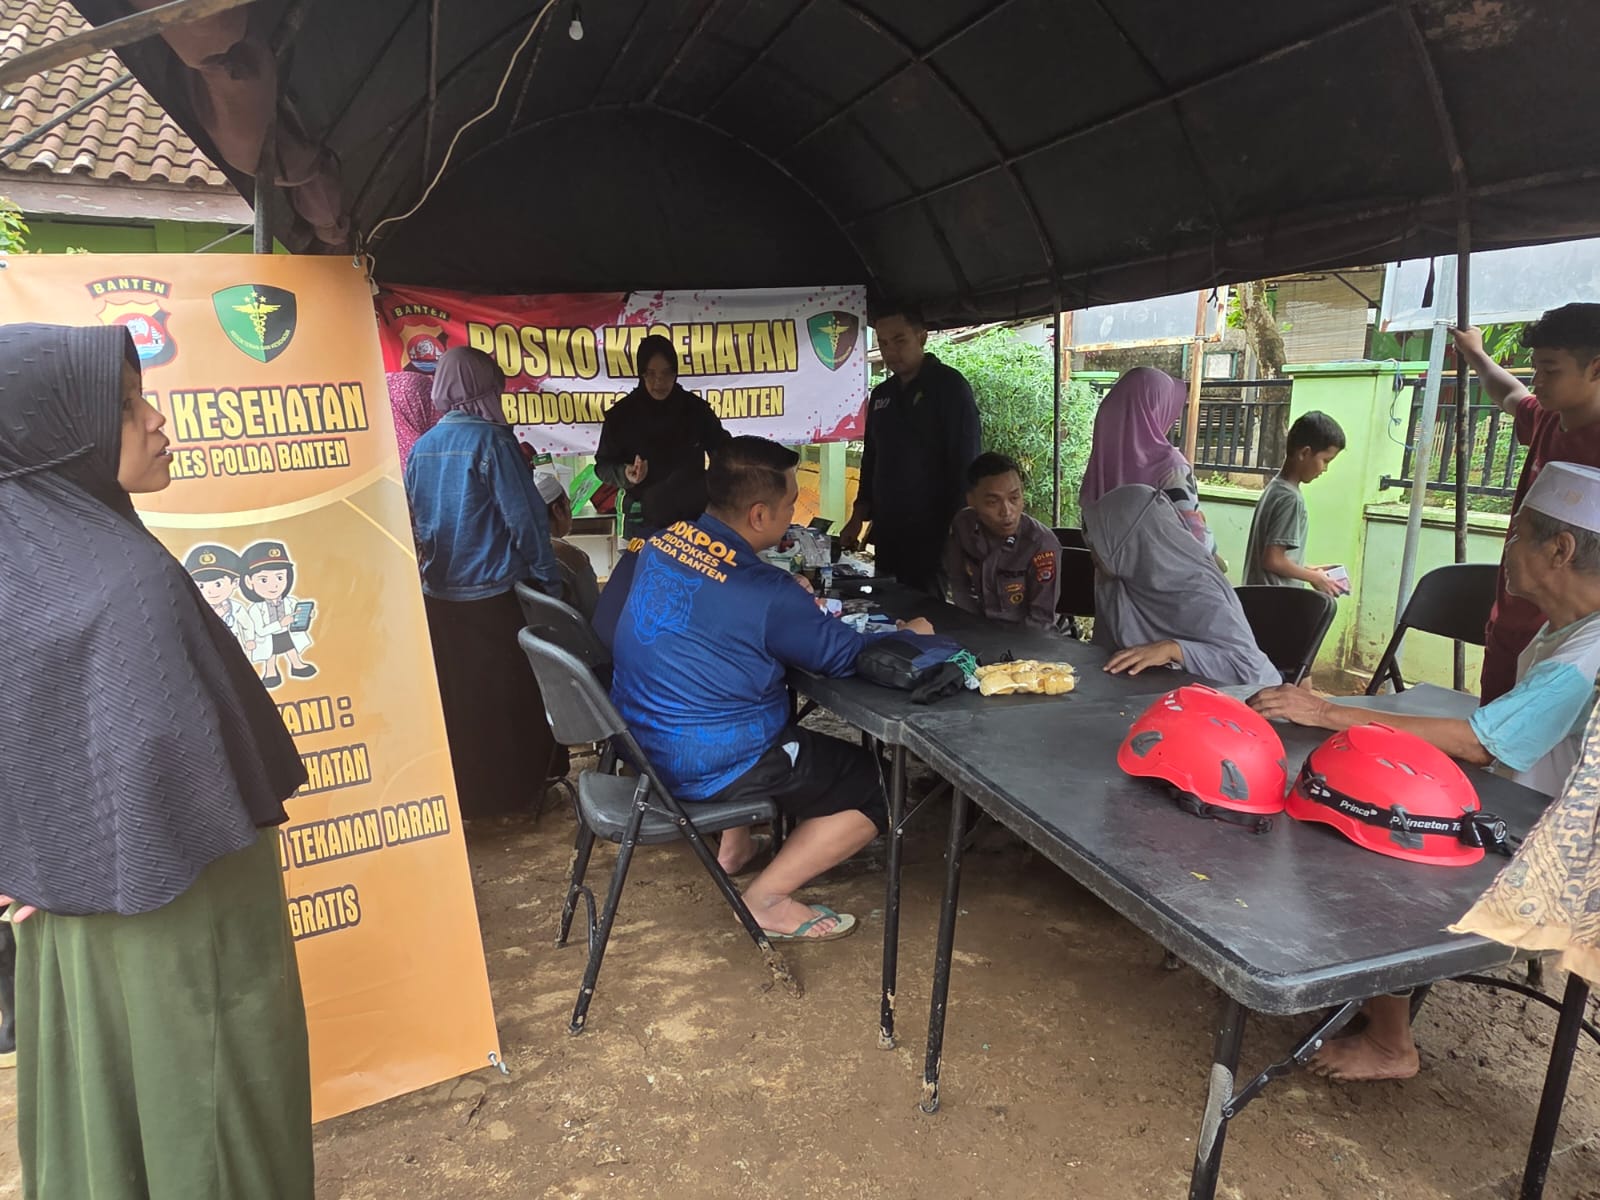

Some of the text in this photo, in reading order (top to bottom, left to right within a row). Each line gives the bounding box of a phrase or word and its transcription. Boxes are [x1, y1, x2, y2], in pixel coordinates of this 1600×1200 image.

[92, 278, 165, 295] BANTEN
[394, 299, 448, 320] BANTEN
[467, 319, 798, 379] POSKO KEEHATAN
[170, 383, 368, 441] KESEHATAN
[707, 385, 784, 420] BANTEN
[210, 443, 275, 476] POLDA
[276, 437, 350, 471] BANTEN
[649, 535, 678, 558] POLDA
[677, 552, 728, 583] BANTEN
[661, 533, 720, 567] BIDDOKKES
[288, 810, 382, 867] TEKANAN
[382, 796, 449, 847] DARAH
[1389, 815, 1449, 831] Pinceton
[288, 886, 360, 938] GRATIS
